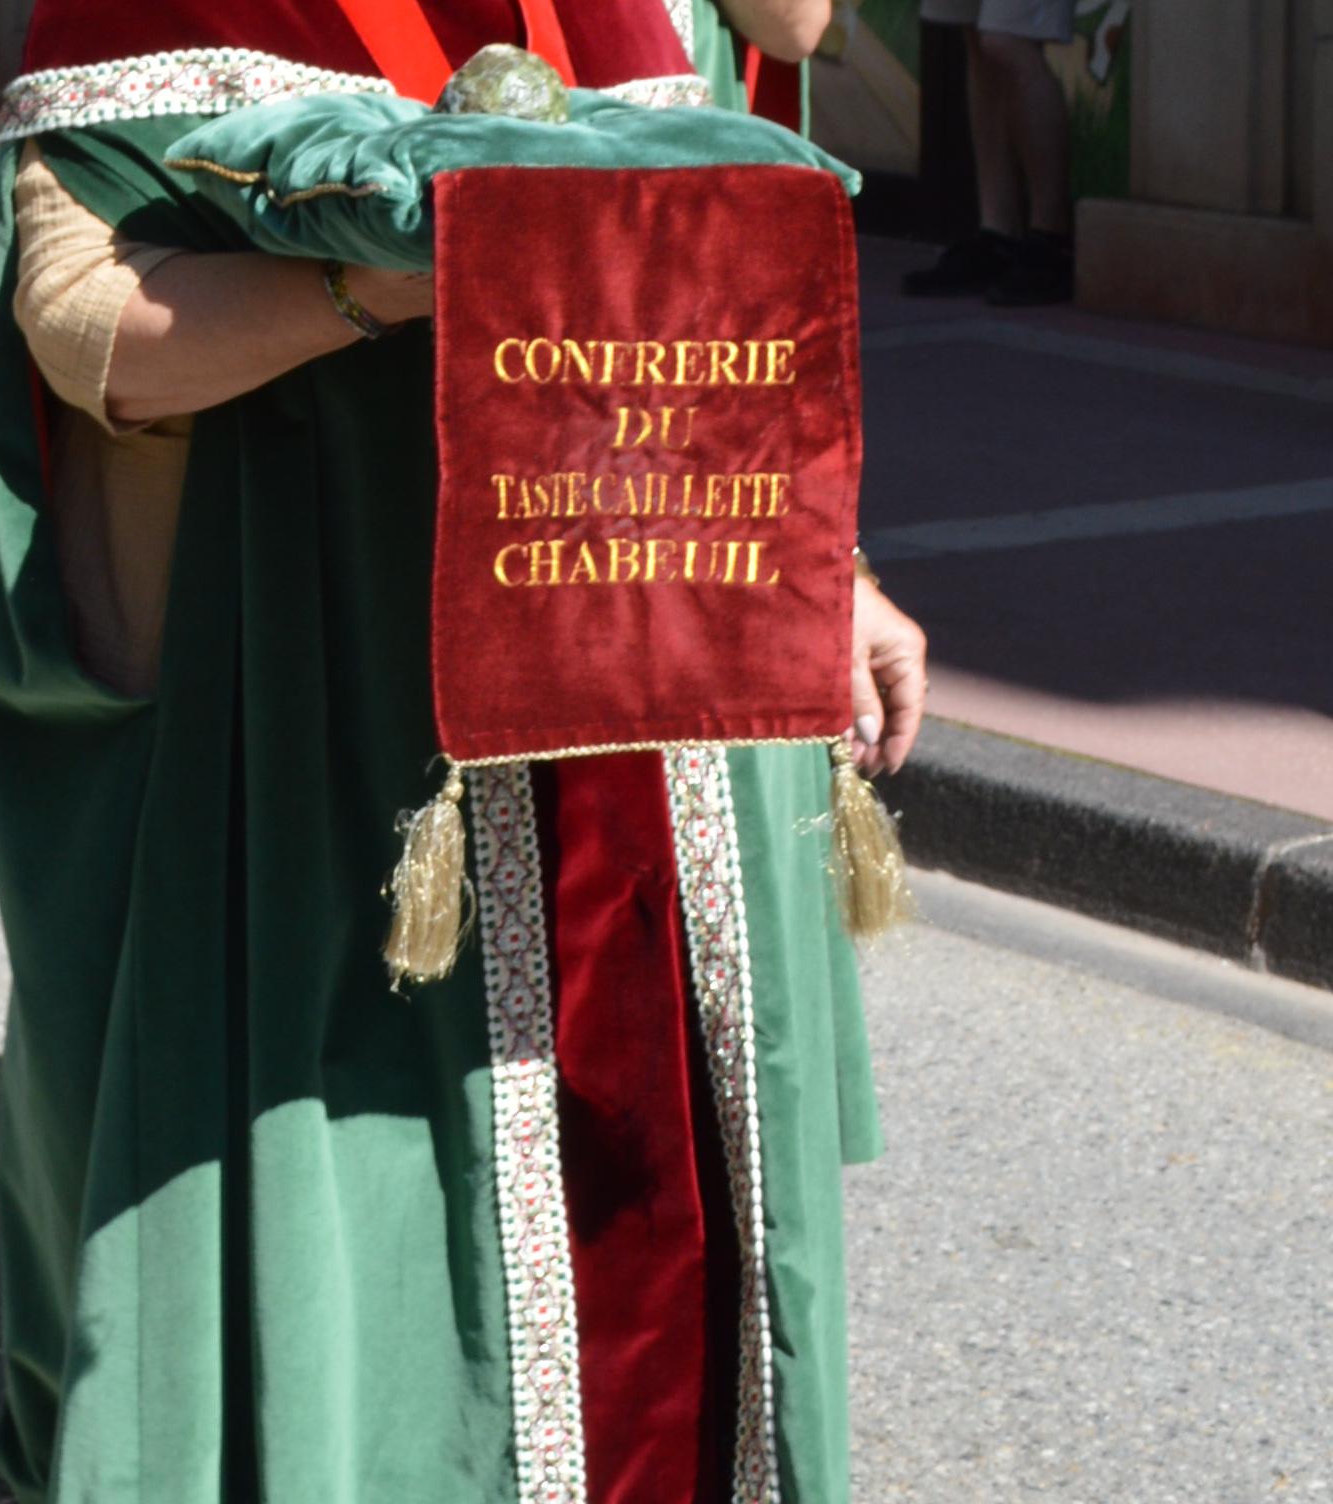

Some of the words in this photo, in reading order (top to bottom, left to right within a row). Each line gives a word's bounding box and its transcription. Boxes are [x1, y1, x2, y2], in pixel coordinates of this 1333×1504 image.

[492, 336, 798, 387] CONFRERIE
[611, 406, 699, 450] DU
[492, 537, 781, 588] CHABEUIL
